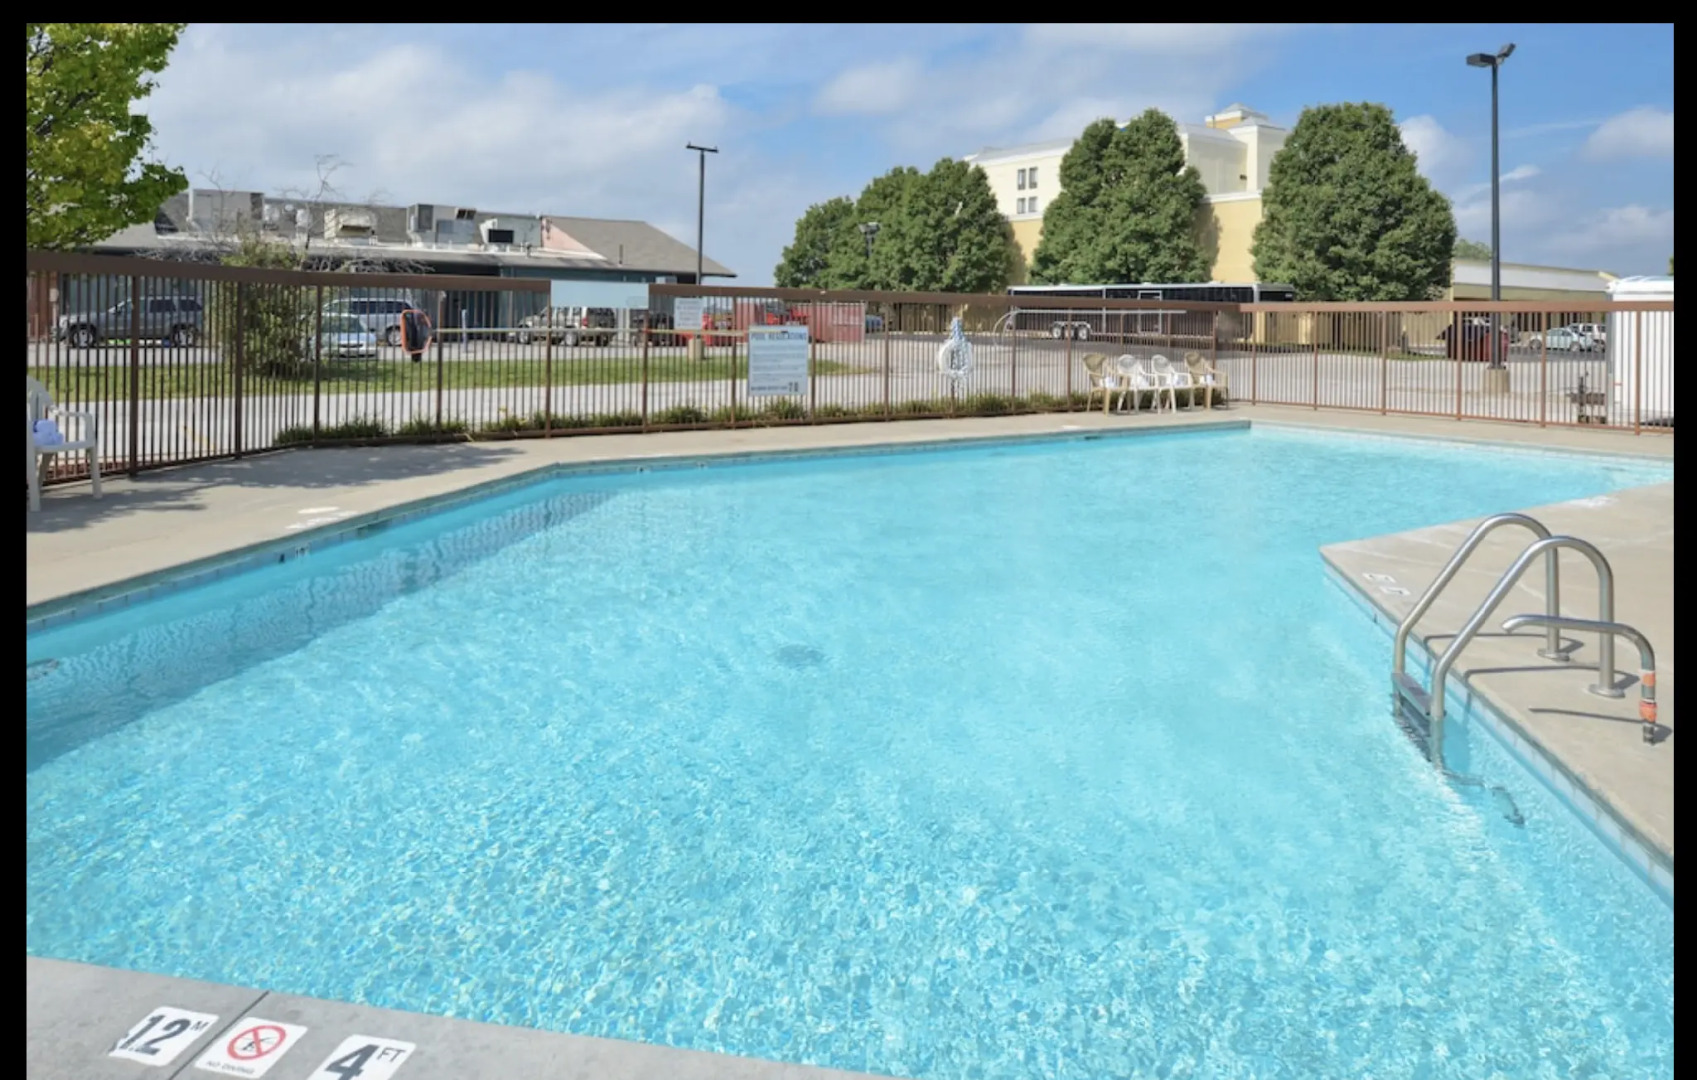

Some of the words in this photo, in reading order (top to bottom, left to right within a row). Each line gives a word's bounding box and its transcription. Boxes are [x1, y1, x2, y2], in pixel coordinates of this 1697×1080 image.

[190, 1020, 209, 1031] M
[206, 1060, 221, 1068] NO
[221, 1062, 255, 1074] DIVING
[324, 1044, 380, 1080] 4
[376, 1046, 407, 1063] FT
